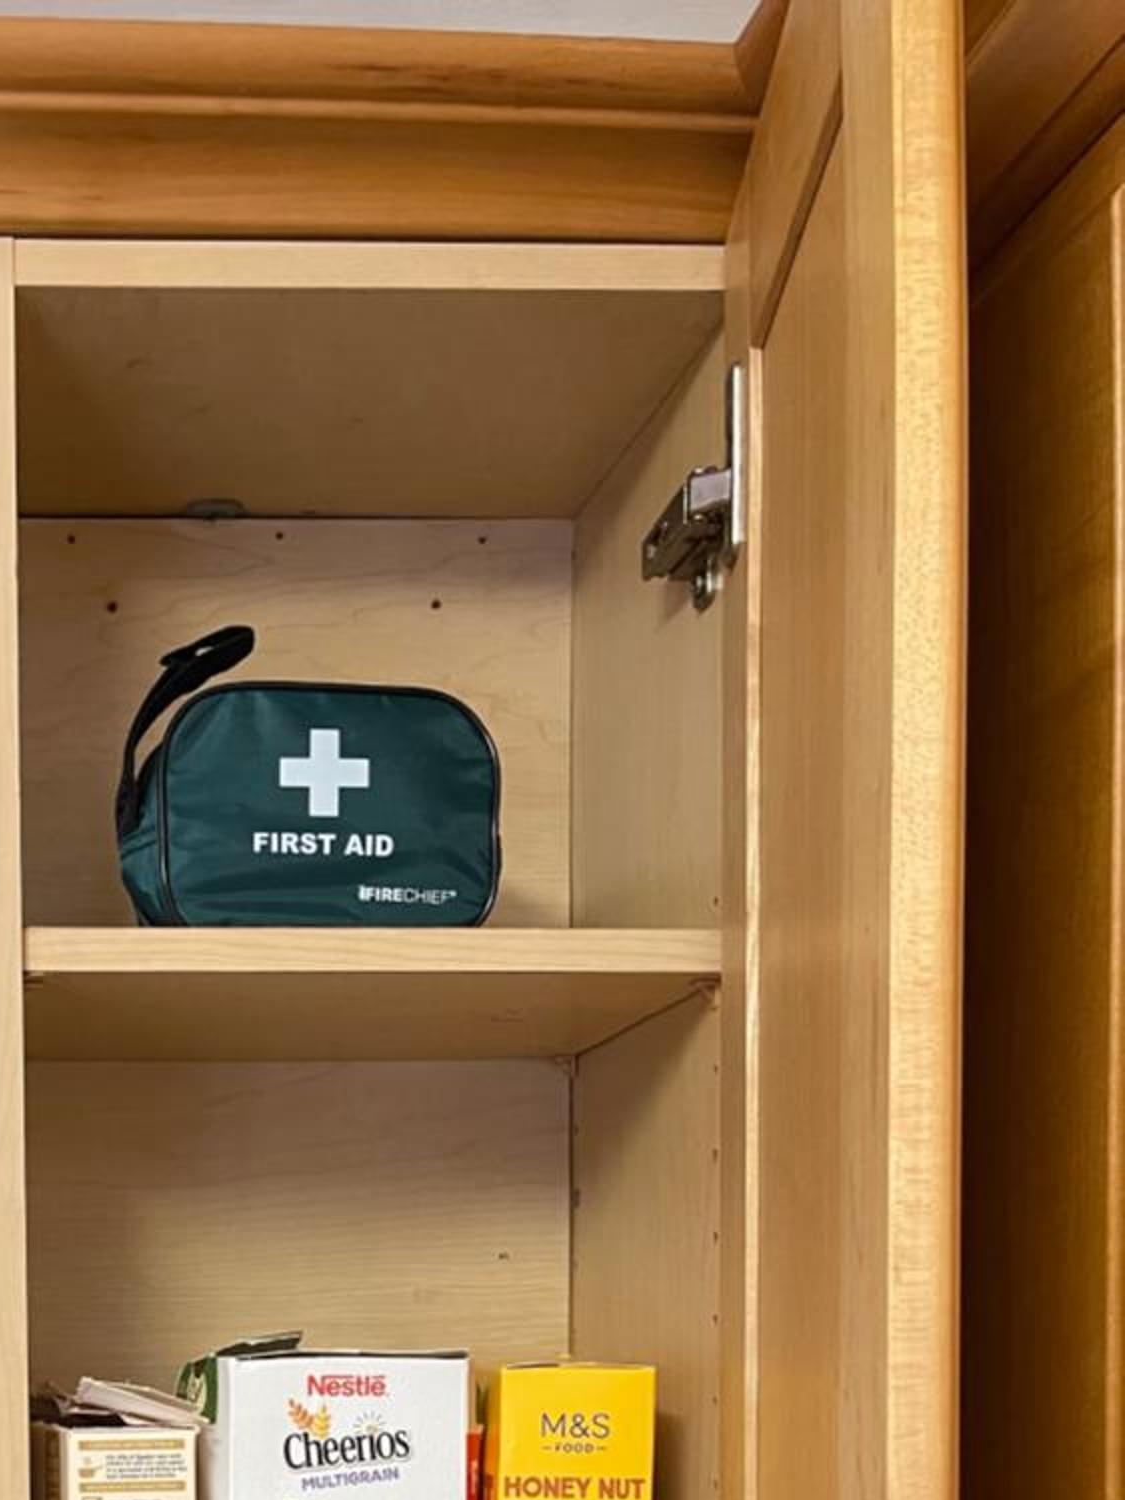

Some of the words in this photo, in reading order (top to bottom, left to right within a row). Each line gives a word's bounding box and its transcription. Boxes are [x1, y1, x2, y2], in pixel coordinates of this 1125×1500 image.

[253, 832, 337, 855] FIRST
[343, 834, 394, 857] AID
[362, 886, 447, 905] FIRECHIEF
[540, 1412, 611, 1439] M&S
[283, 1429, 410, 1470] Cheerios
[301, 1467, 400, 1491] MULTIGRAIN
[504, 1476, 592, 1499] HONEY
[598, 1477, 646, 1500] NUT
